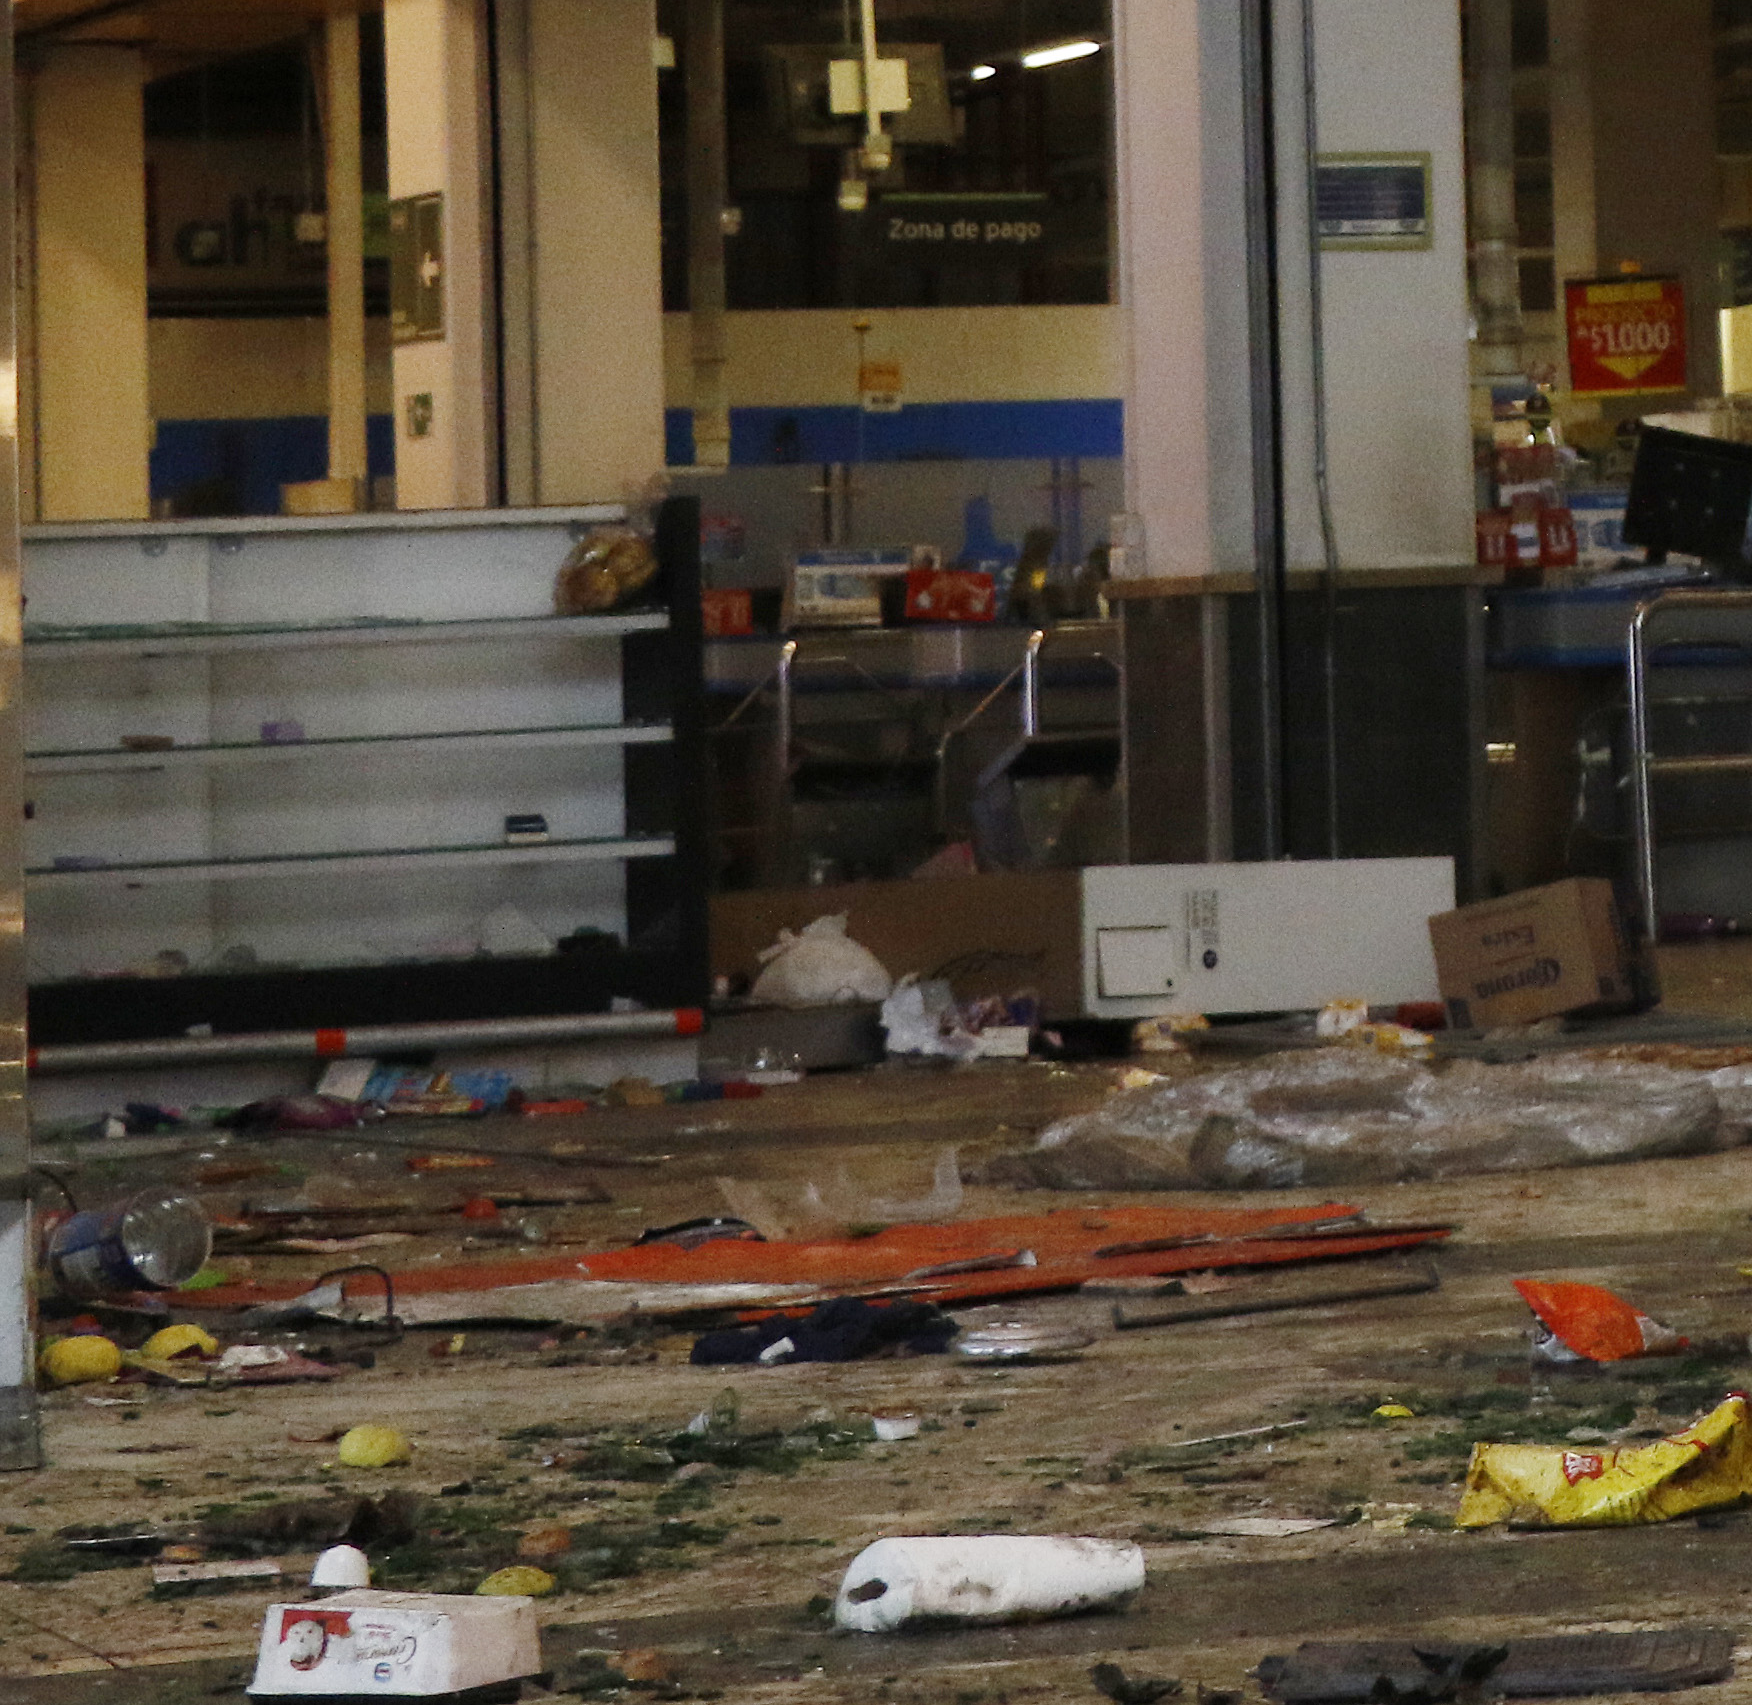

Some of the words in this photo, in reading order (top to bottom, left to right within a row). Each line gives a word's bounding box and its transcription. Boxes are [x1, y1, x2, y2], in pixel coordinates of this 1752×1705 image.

[889, 217, 945, 240] Zona
[951, 218, 979, 240] de
[983, 222, 1042, 244] pago
